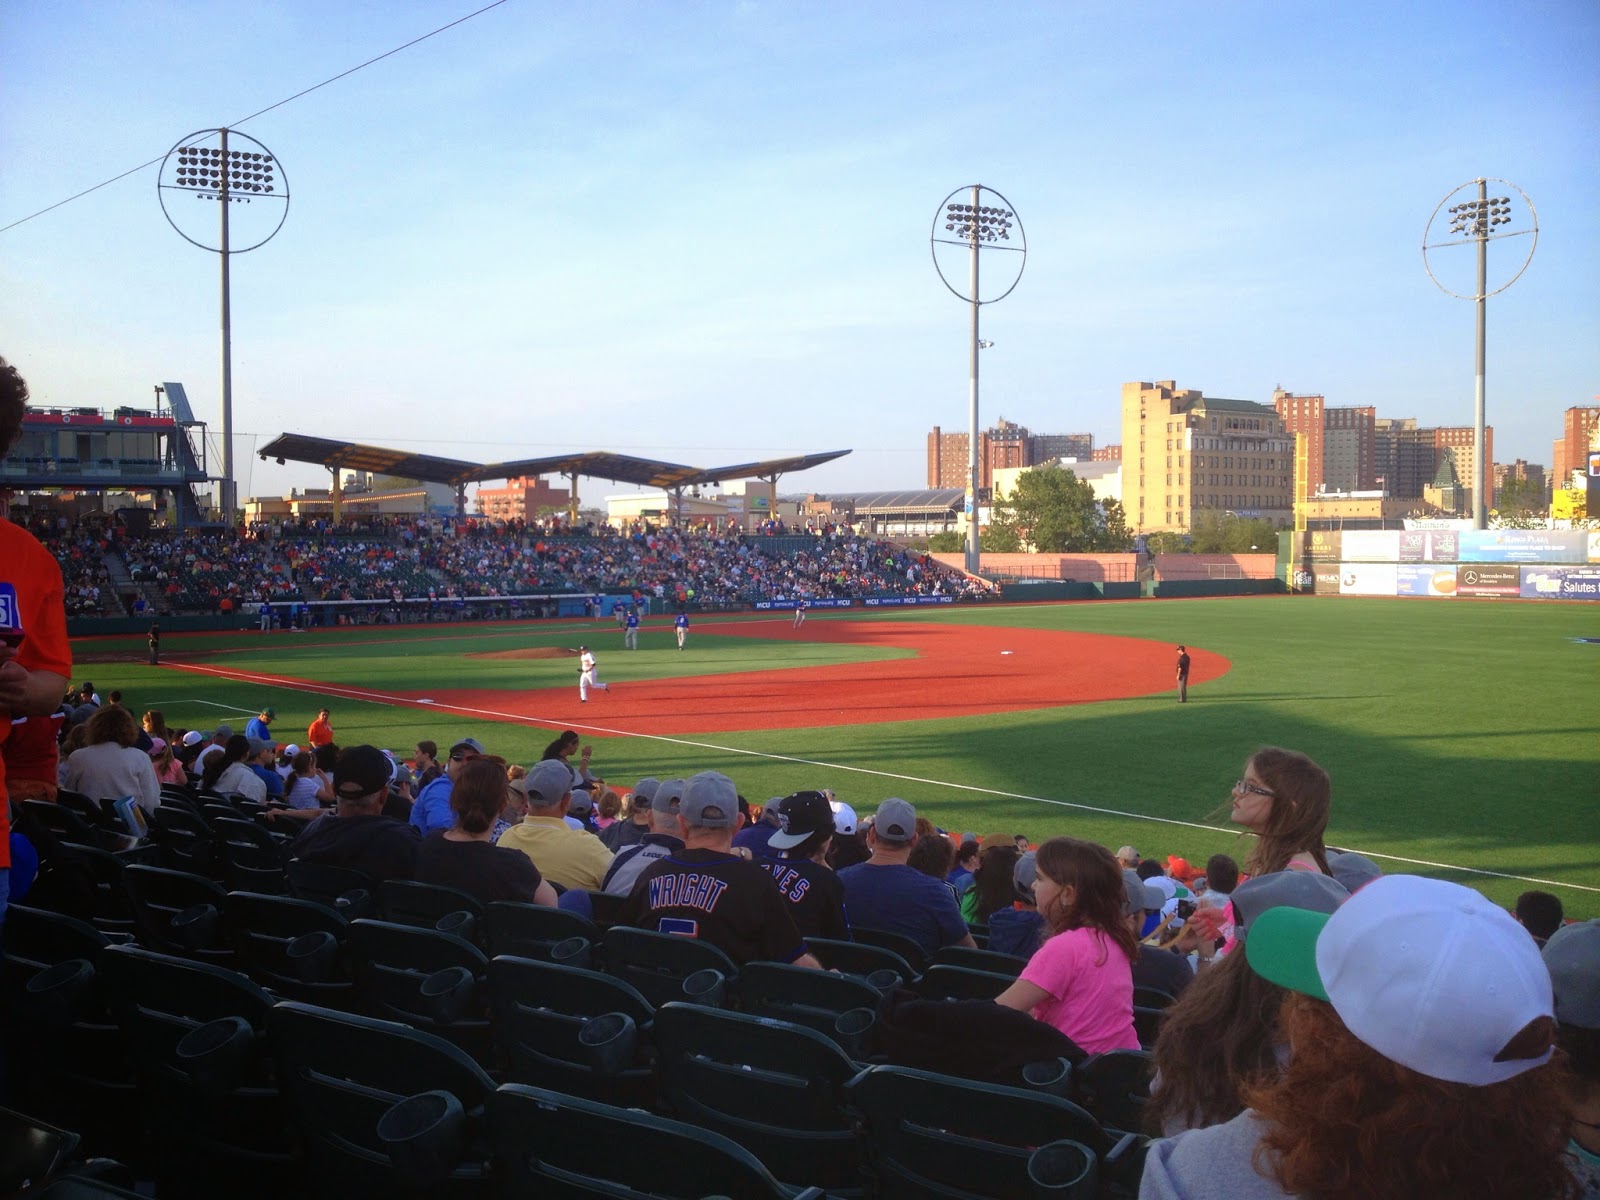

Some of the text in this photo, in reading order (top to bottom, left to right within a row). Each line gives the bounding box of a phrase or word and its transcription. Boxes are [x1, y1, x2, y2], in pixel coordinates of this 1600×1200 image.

[1563, 581, 1597, 593] Salutes
[648, 872, 729, 914] WRIGHT
[760, 864, 811, 903] YES
